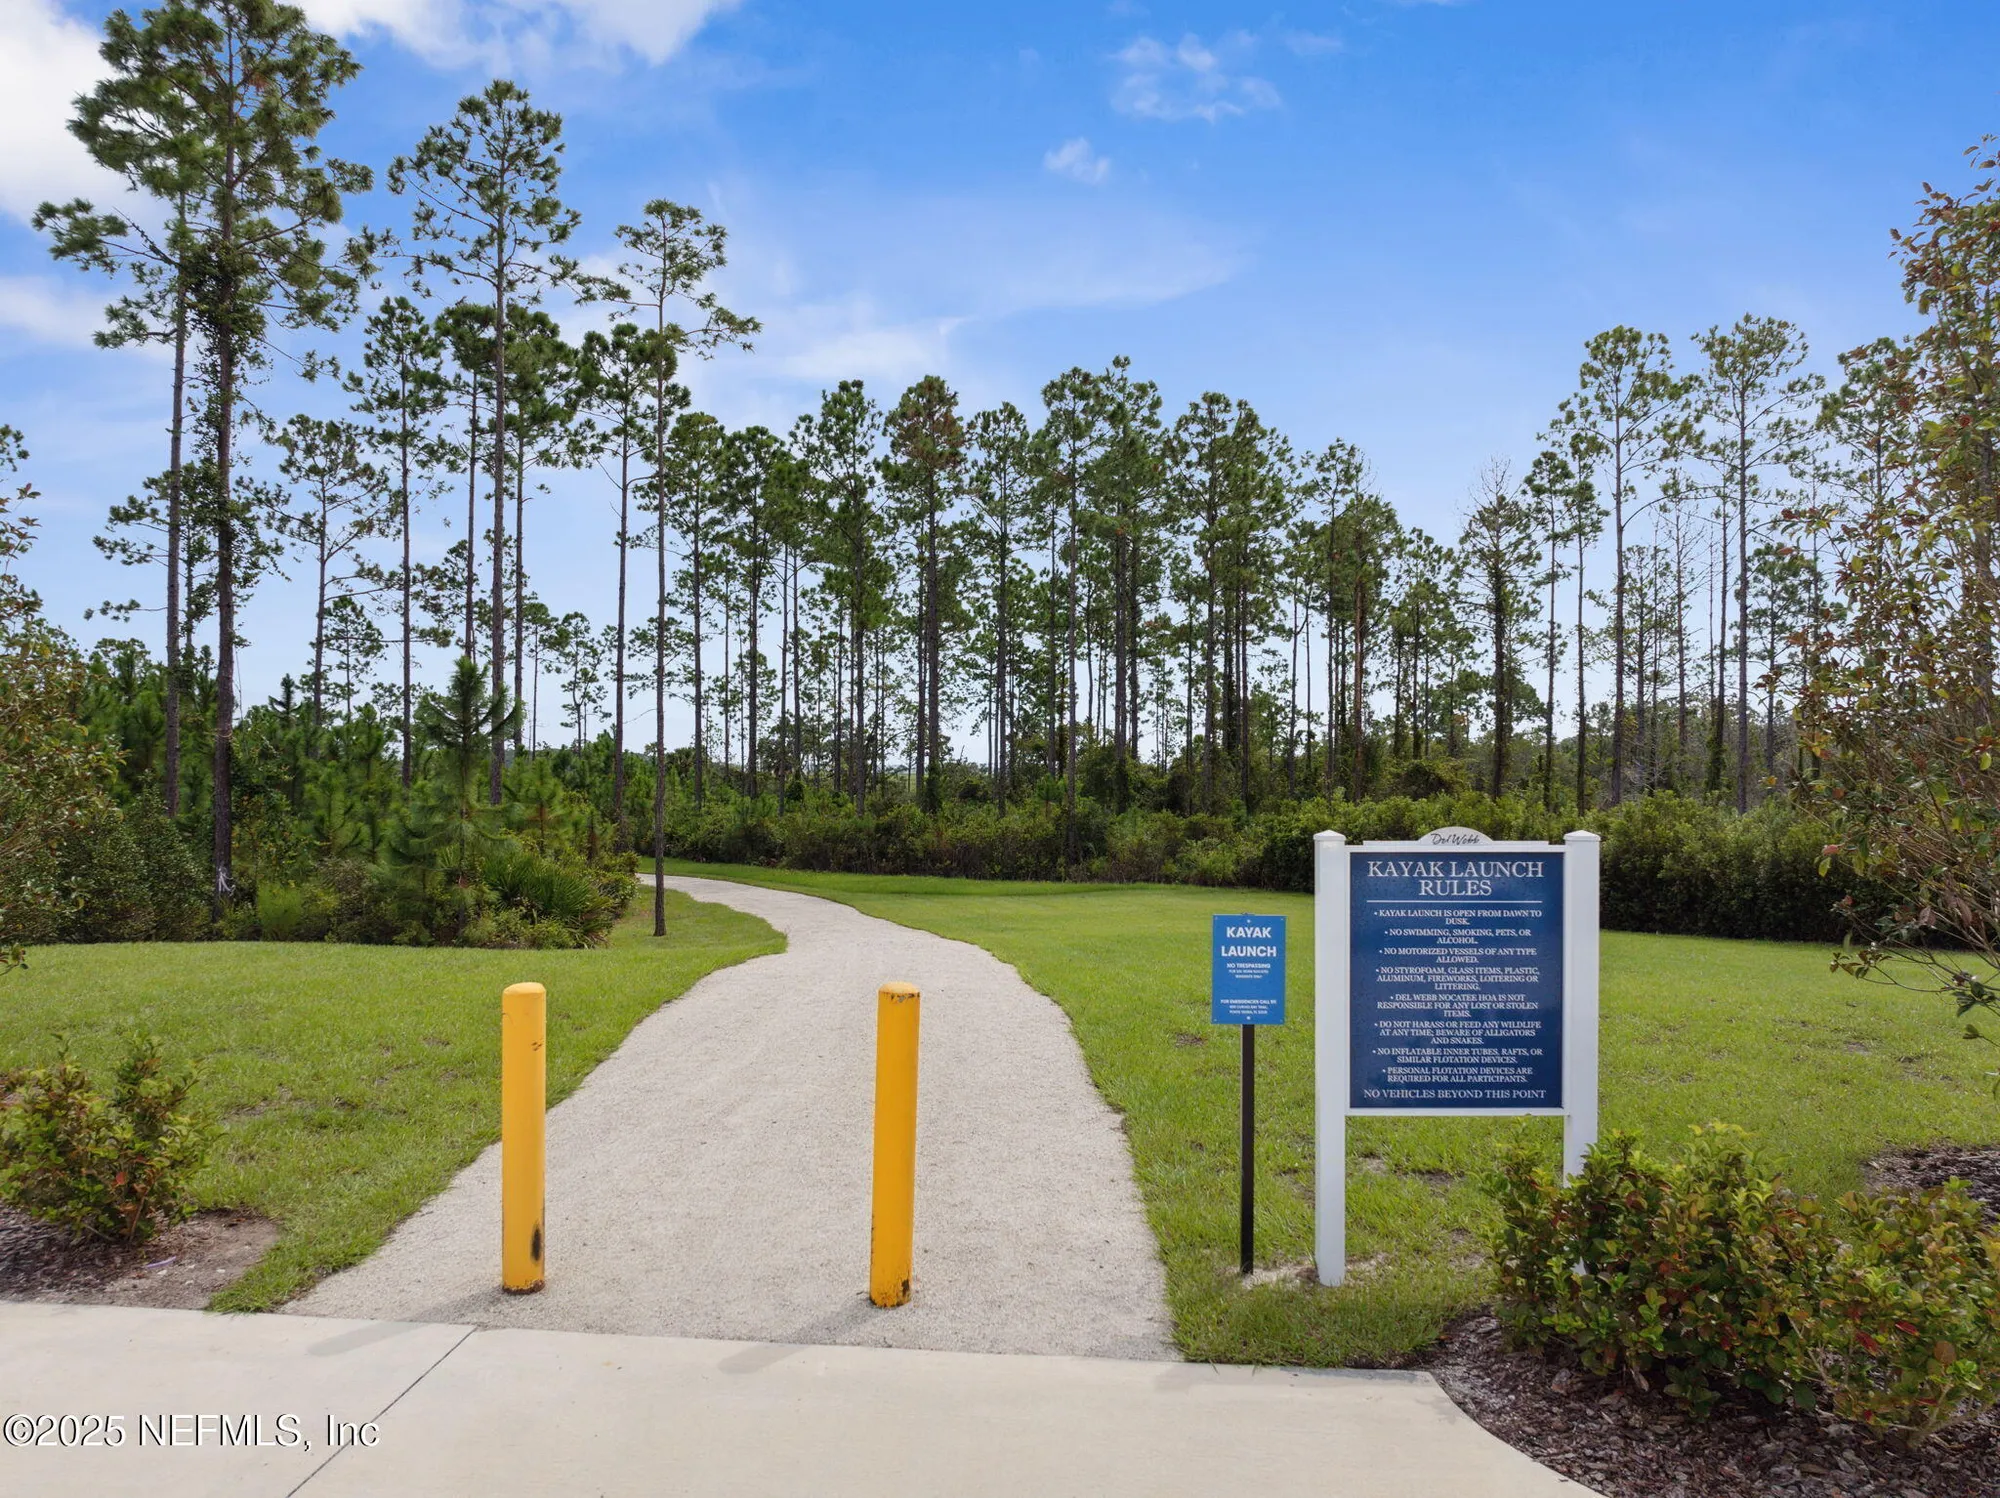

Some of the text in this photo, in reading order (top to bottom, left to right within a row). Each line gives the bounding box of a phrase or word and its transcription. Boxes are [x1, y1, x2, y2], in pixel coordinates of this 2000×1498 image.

[1430, 833, 1480, 845] Del Webb
[1368, 861, 1544, 877] KAYAK LAUNCH
[1419, 880, 1492, 896] RULES
[1227, 927, 1271, 938] KAYAK
[1221, 946, 1276, 957] LAUNCH
[1377, 975, 1538, 983] ALUMINUM, FIREWORKS, LOITERING OR
[1444, 1010, 1471, 1018] ITEMS.
[1378, 1048, 1542, 1056] NO INFLATABLE INNER TUBES, RAFTS, OR
[1388, 1075, 1527, 1083] REQUIRED FOR ALL PARTICIPANTS.
[1364, 1090, 1546, 1099] NO VEHICLES BEYOND THIS POINT
